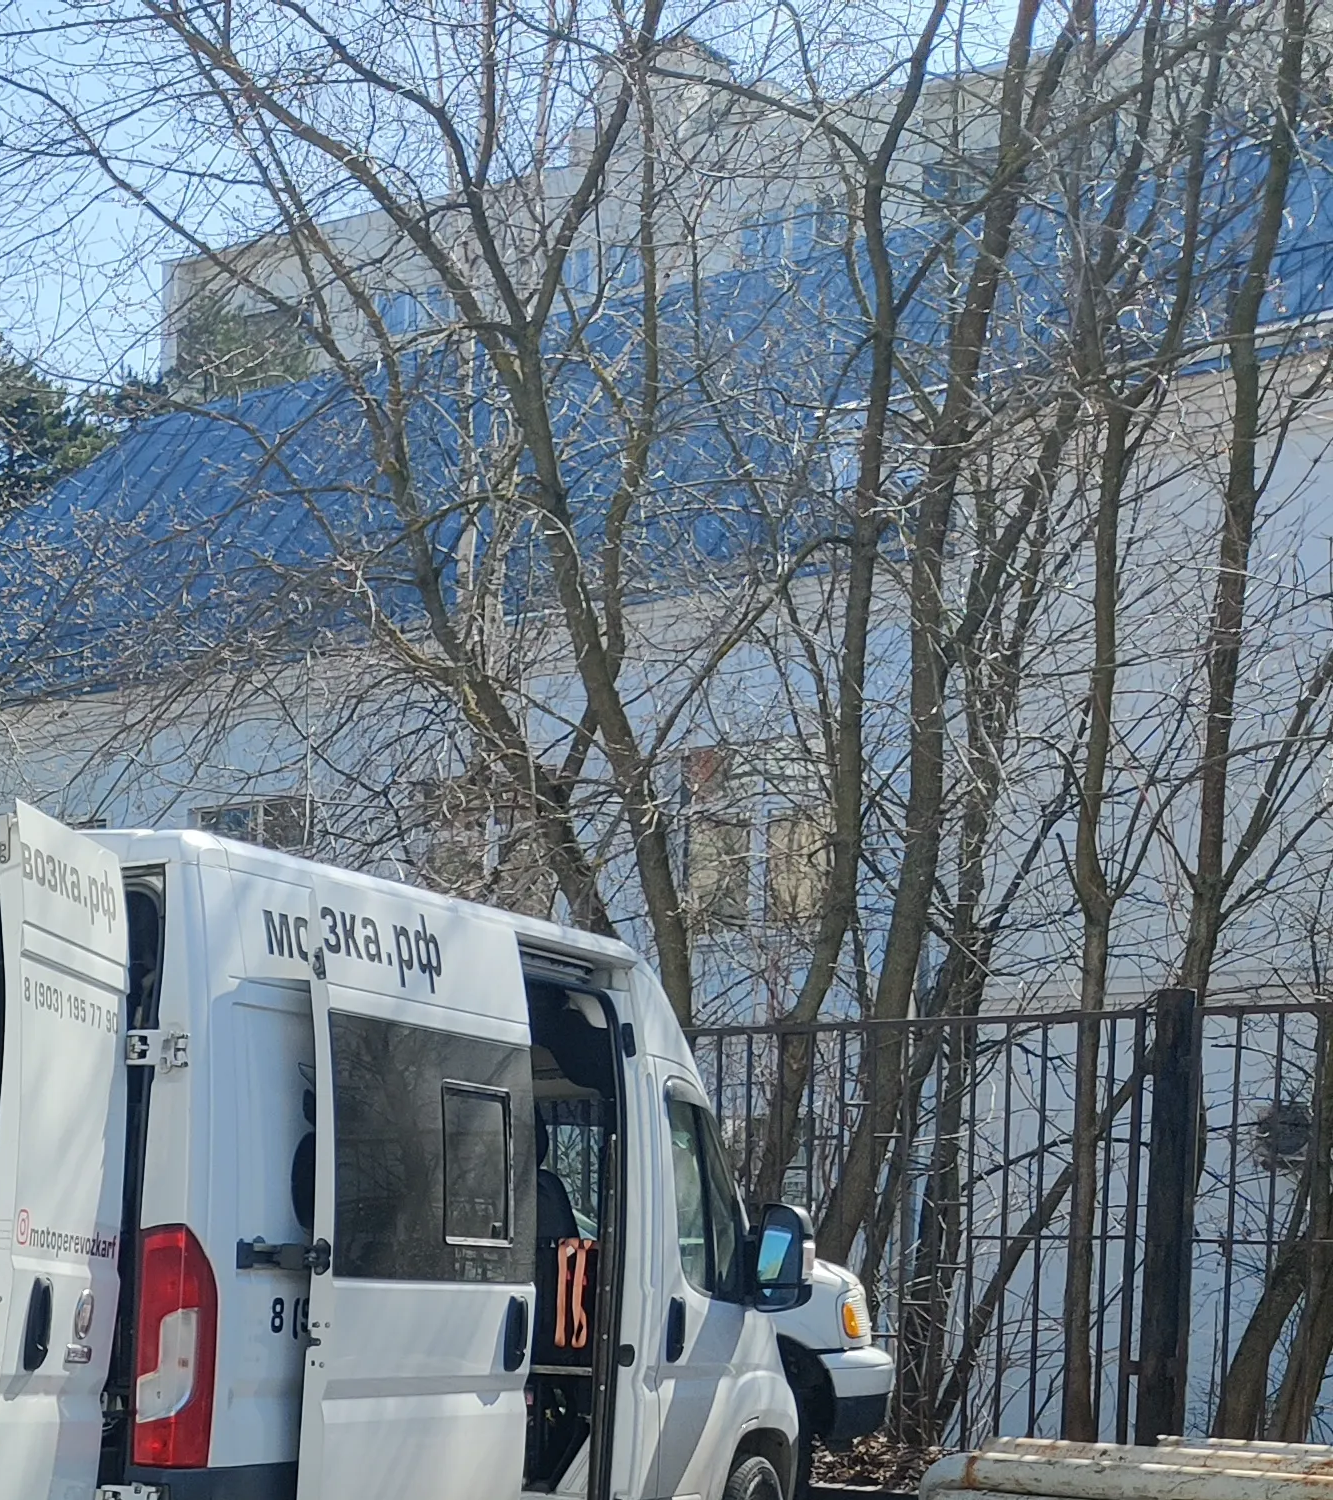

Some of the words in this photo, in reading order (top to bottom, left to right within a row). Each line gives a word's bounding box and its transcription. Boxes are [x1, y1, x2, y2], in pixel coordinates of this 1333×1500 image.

[20, 841, 116, 934] возка.рф
[24, 976, 31, 1002] 8
[34, 980, 63, 1020] (903)
[66, 993, 87, 1023] 195
[89, 1002, 102, 1029] 77
[28, 1226, 117, 1260] motoperevozkarf
[271, 1297, 284, 1334] 8
